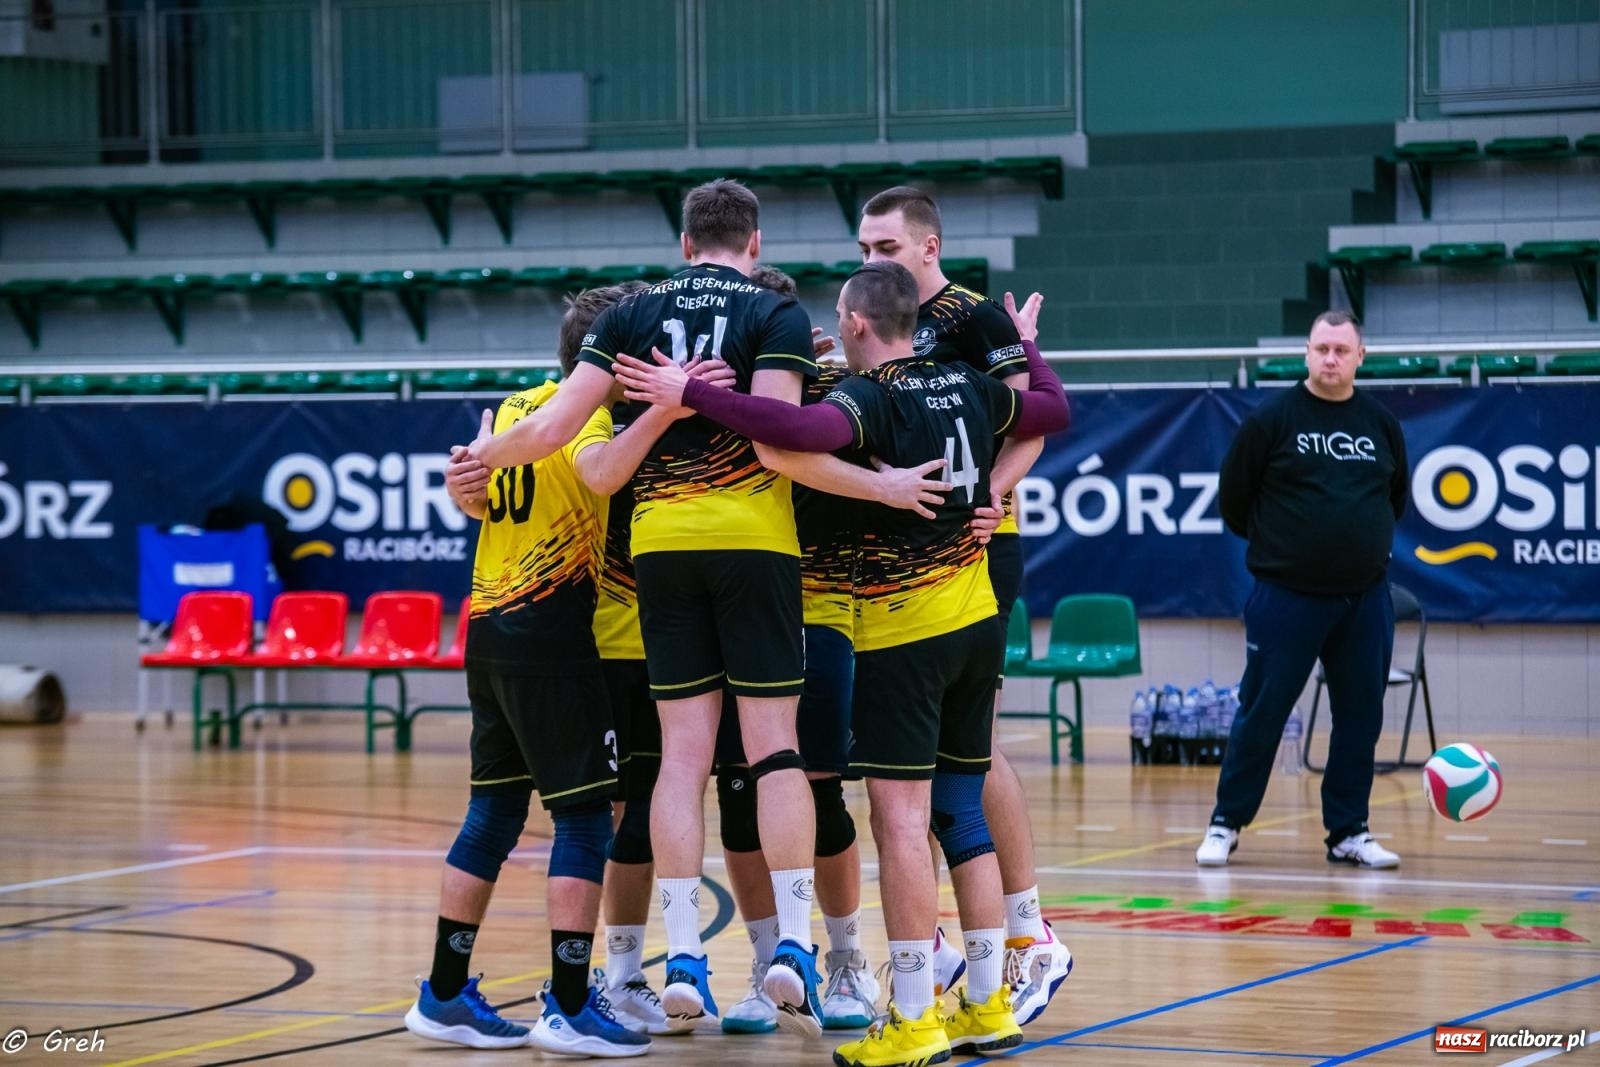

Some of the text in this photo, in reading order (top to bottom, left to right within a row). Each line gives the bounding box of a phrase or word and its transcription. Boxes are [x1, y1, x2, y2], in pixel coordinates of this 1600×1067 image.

[647, 278, 690, 295] TALENT
[676, 294, 727, 310] CIESZYN
[941, 417, 979, 503] 4
[1411, 444, 1600, 532] OSi
[343, 532, 467, 561] RACIBÓRZ
